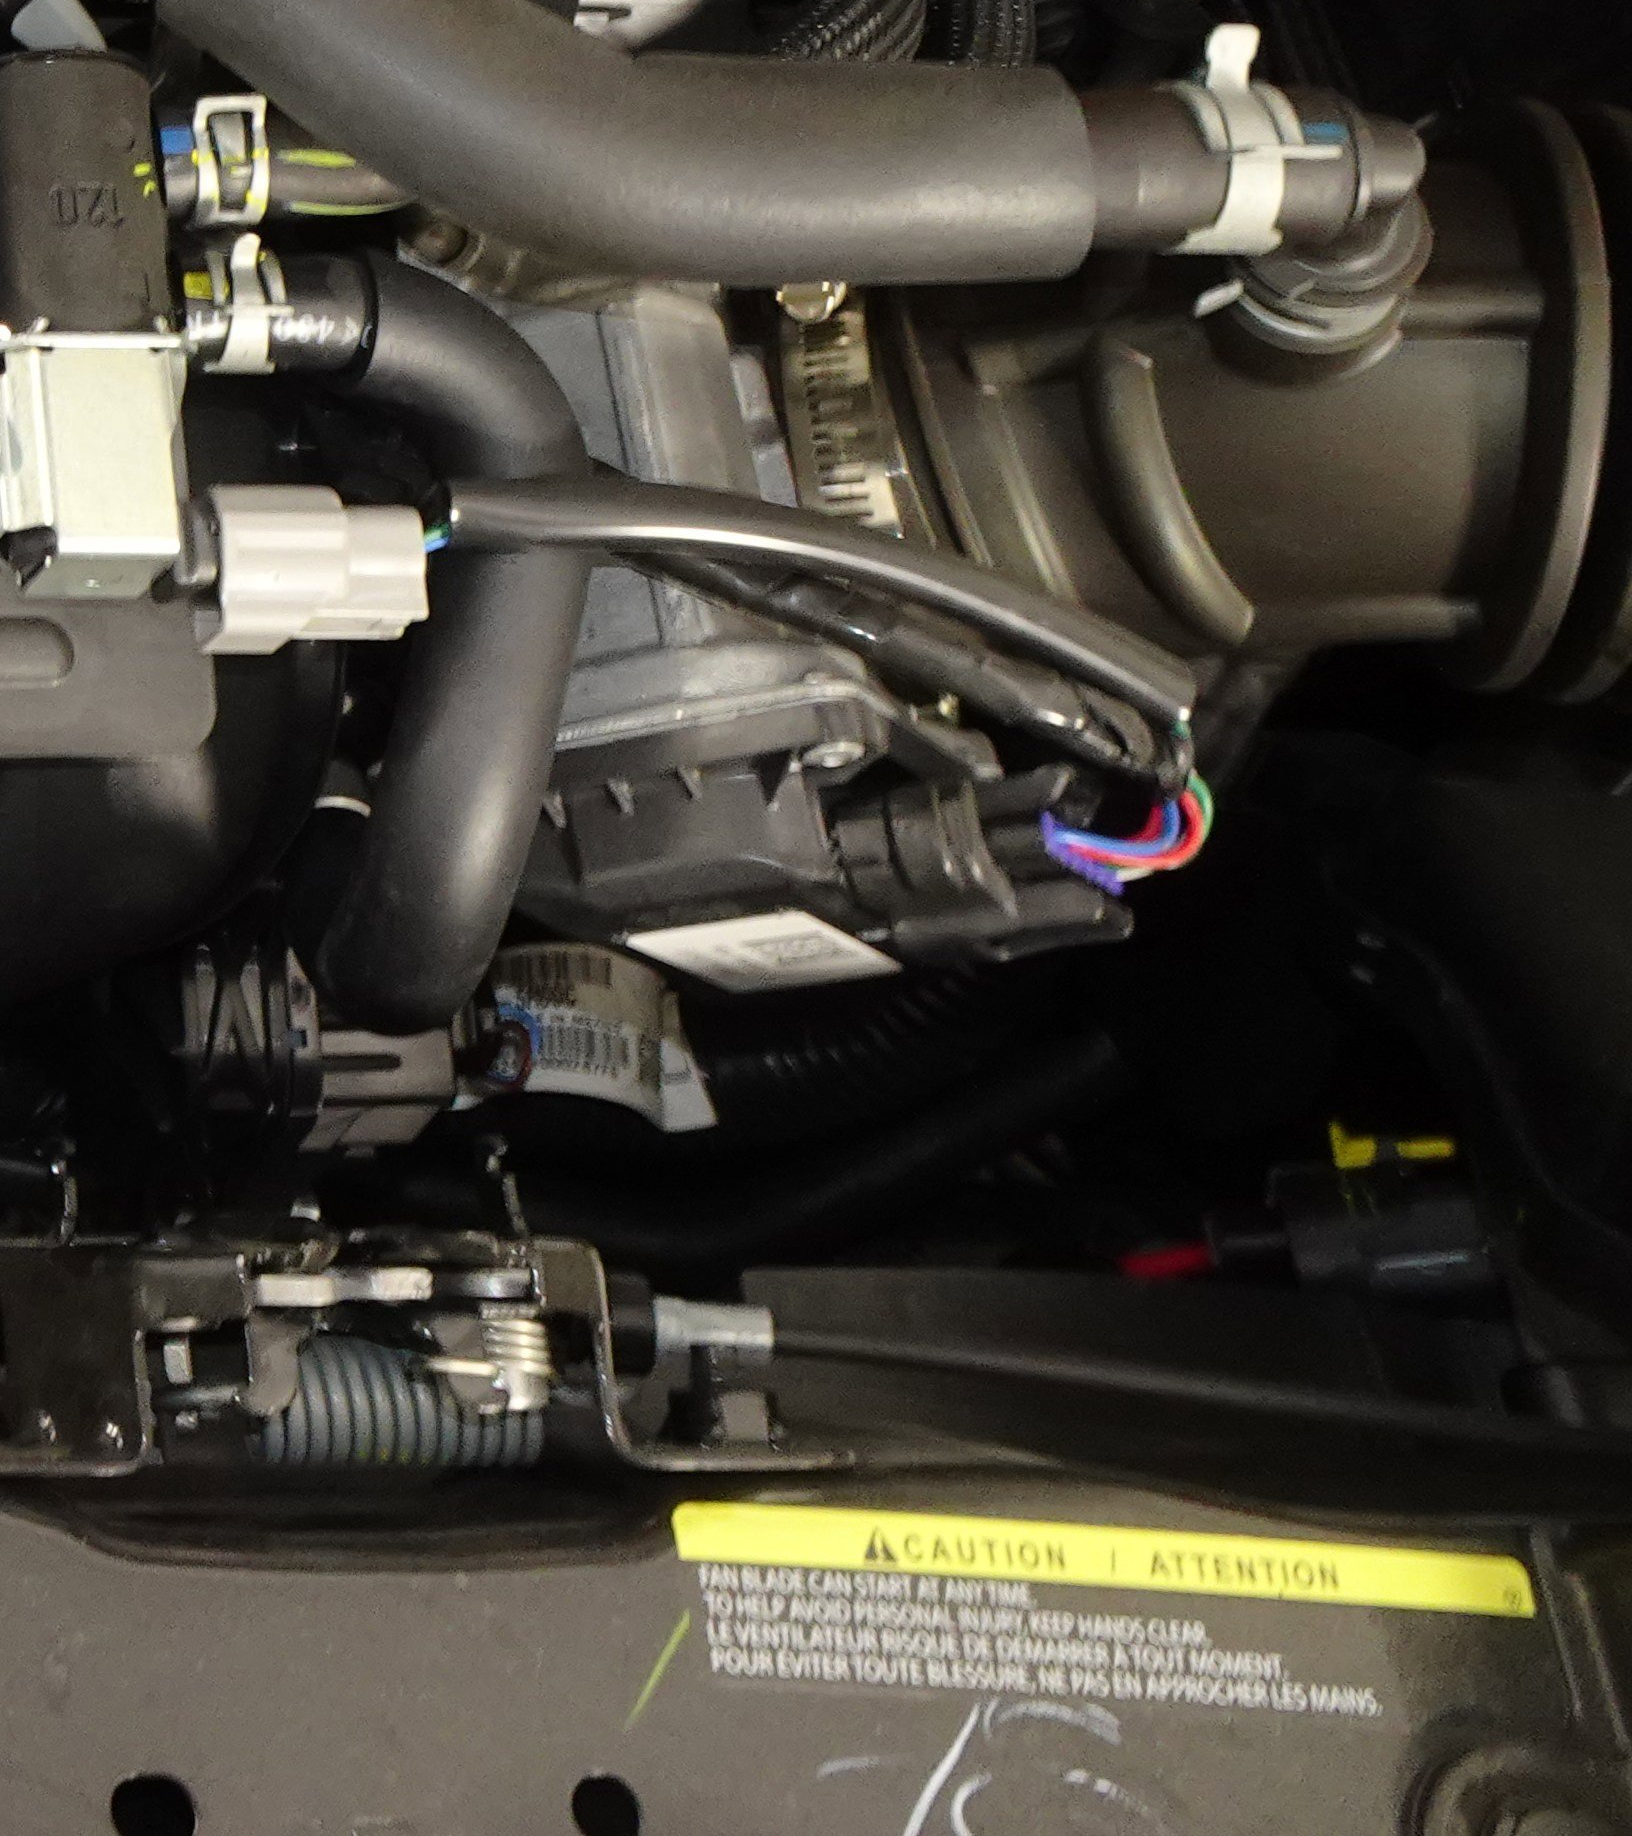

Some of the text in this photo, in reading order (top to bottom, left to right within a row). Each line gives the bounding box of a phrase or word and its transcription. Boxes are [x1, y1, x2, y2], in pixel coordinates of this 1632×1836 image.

[698, 1562, 739, 1590] FAN
[742, 1564, 806, 1596] BLADE
[809, 1569, 852, 1598] CAN
[854, 1572, 912, 1602] START
[917, 1577, 940, 1604] AT
[945, 1578, 984, 1607] ANY
[903, 1533, 1066, 1571] CAUTION
[1150, 1550, 1339, 1591] ATTENTION
[704, 1588, 734, 1620] TO
[736, 1590, 787, 1622] HELP
[789, 1594, 852, 1626] AVOID
[854, 1598, 952, 1632] PERSONAL
[1028, 1609, 1076, 1640] KEEP
[1077, 1612, 1146, 1645] HANDS
[707, 1616, 734, 1646] LE
[734, 1617, 879, 1656] VENTILATEUR
[881, 1627, 960, 1661] RISQUE
[963, 1632, 992, 1662] DE
[1130, 1643, 1184, 1675] TOUT
[711, 1644, 775, 1678] POUR
[851, 1653, 923, 1687] TOUTE
[1037, 1664, 1067, 1696] NE
[1071, 1667, 1109, 1698] PAS
[1111, 1669, 1143, 1701] EN
[1146, 1671, 1269, 1710] APPROCHER
[1270, 1680, 1307, 1712] LES
